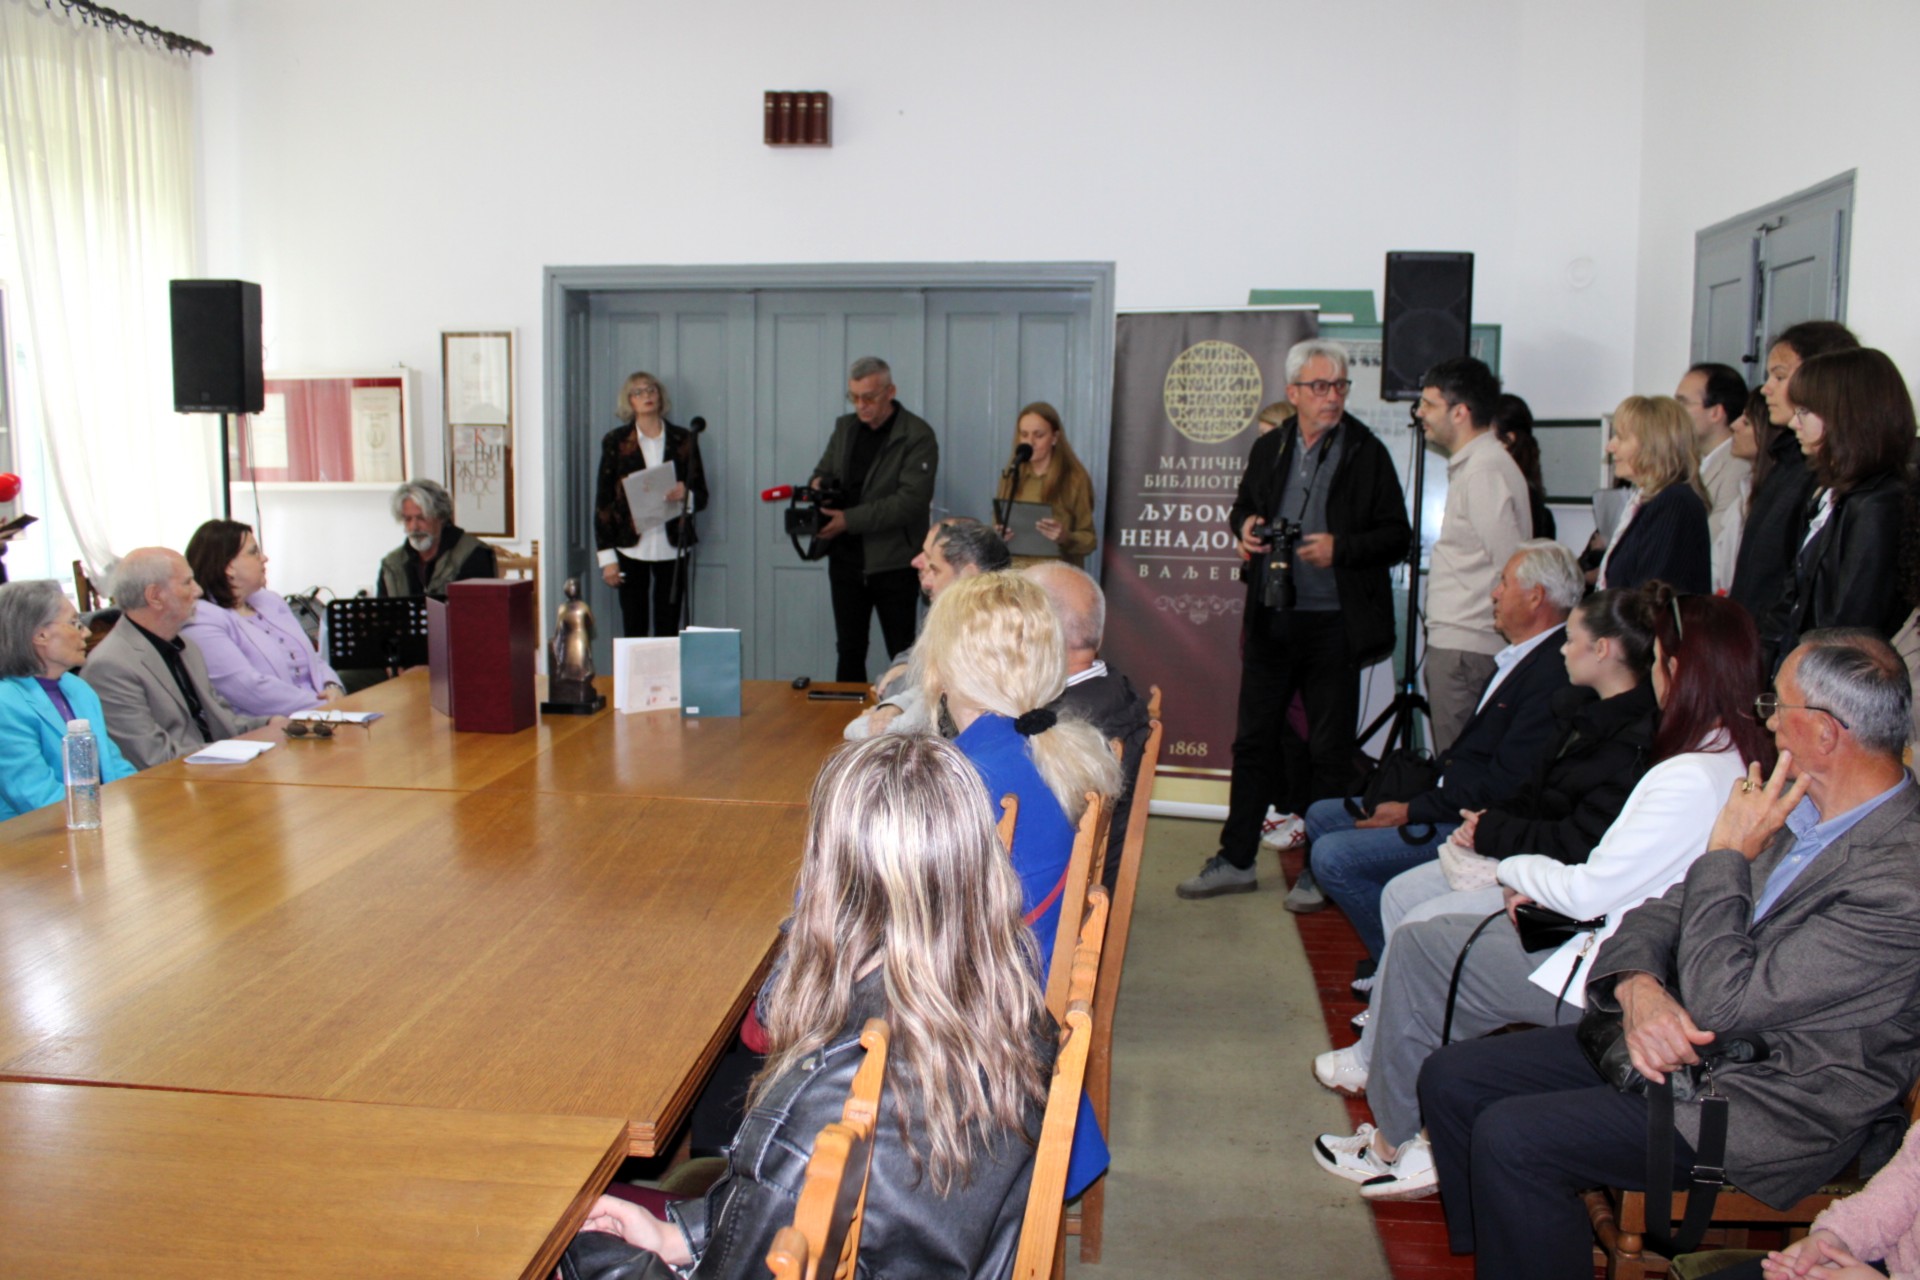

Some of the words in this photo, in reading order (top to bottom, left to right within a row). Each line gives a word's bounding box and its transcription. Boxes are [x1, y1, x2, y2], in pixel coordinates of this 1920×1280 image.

[1144, 474, 1241, 489] БИБЛИОТЕ
[1138, 503, 1234, 523] ЉУБОМ
[1120, 528, 1239, 552] НЕНАДО
[1139, 564, 1241, 581] ВАЉЕВ
[1168, 741, 1208, 757] 1868
